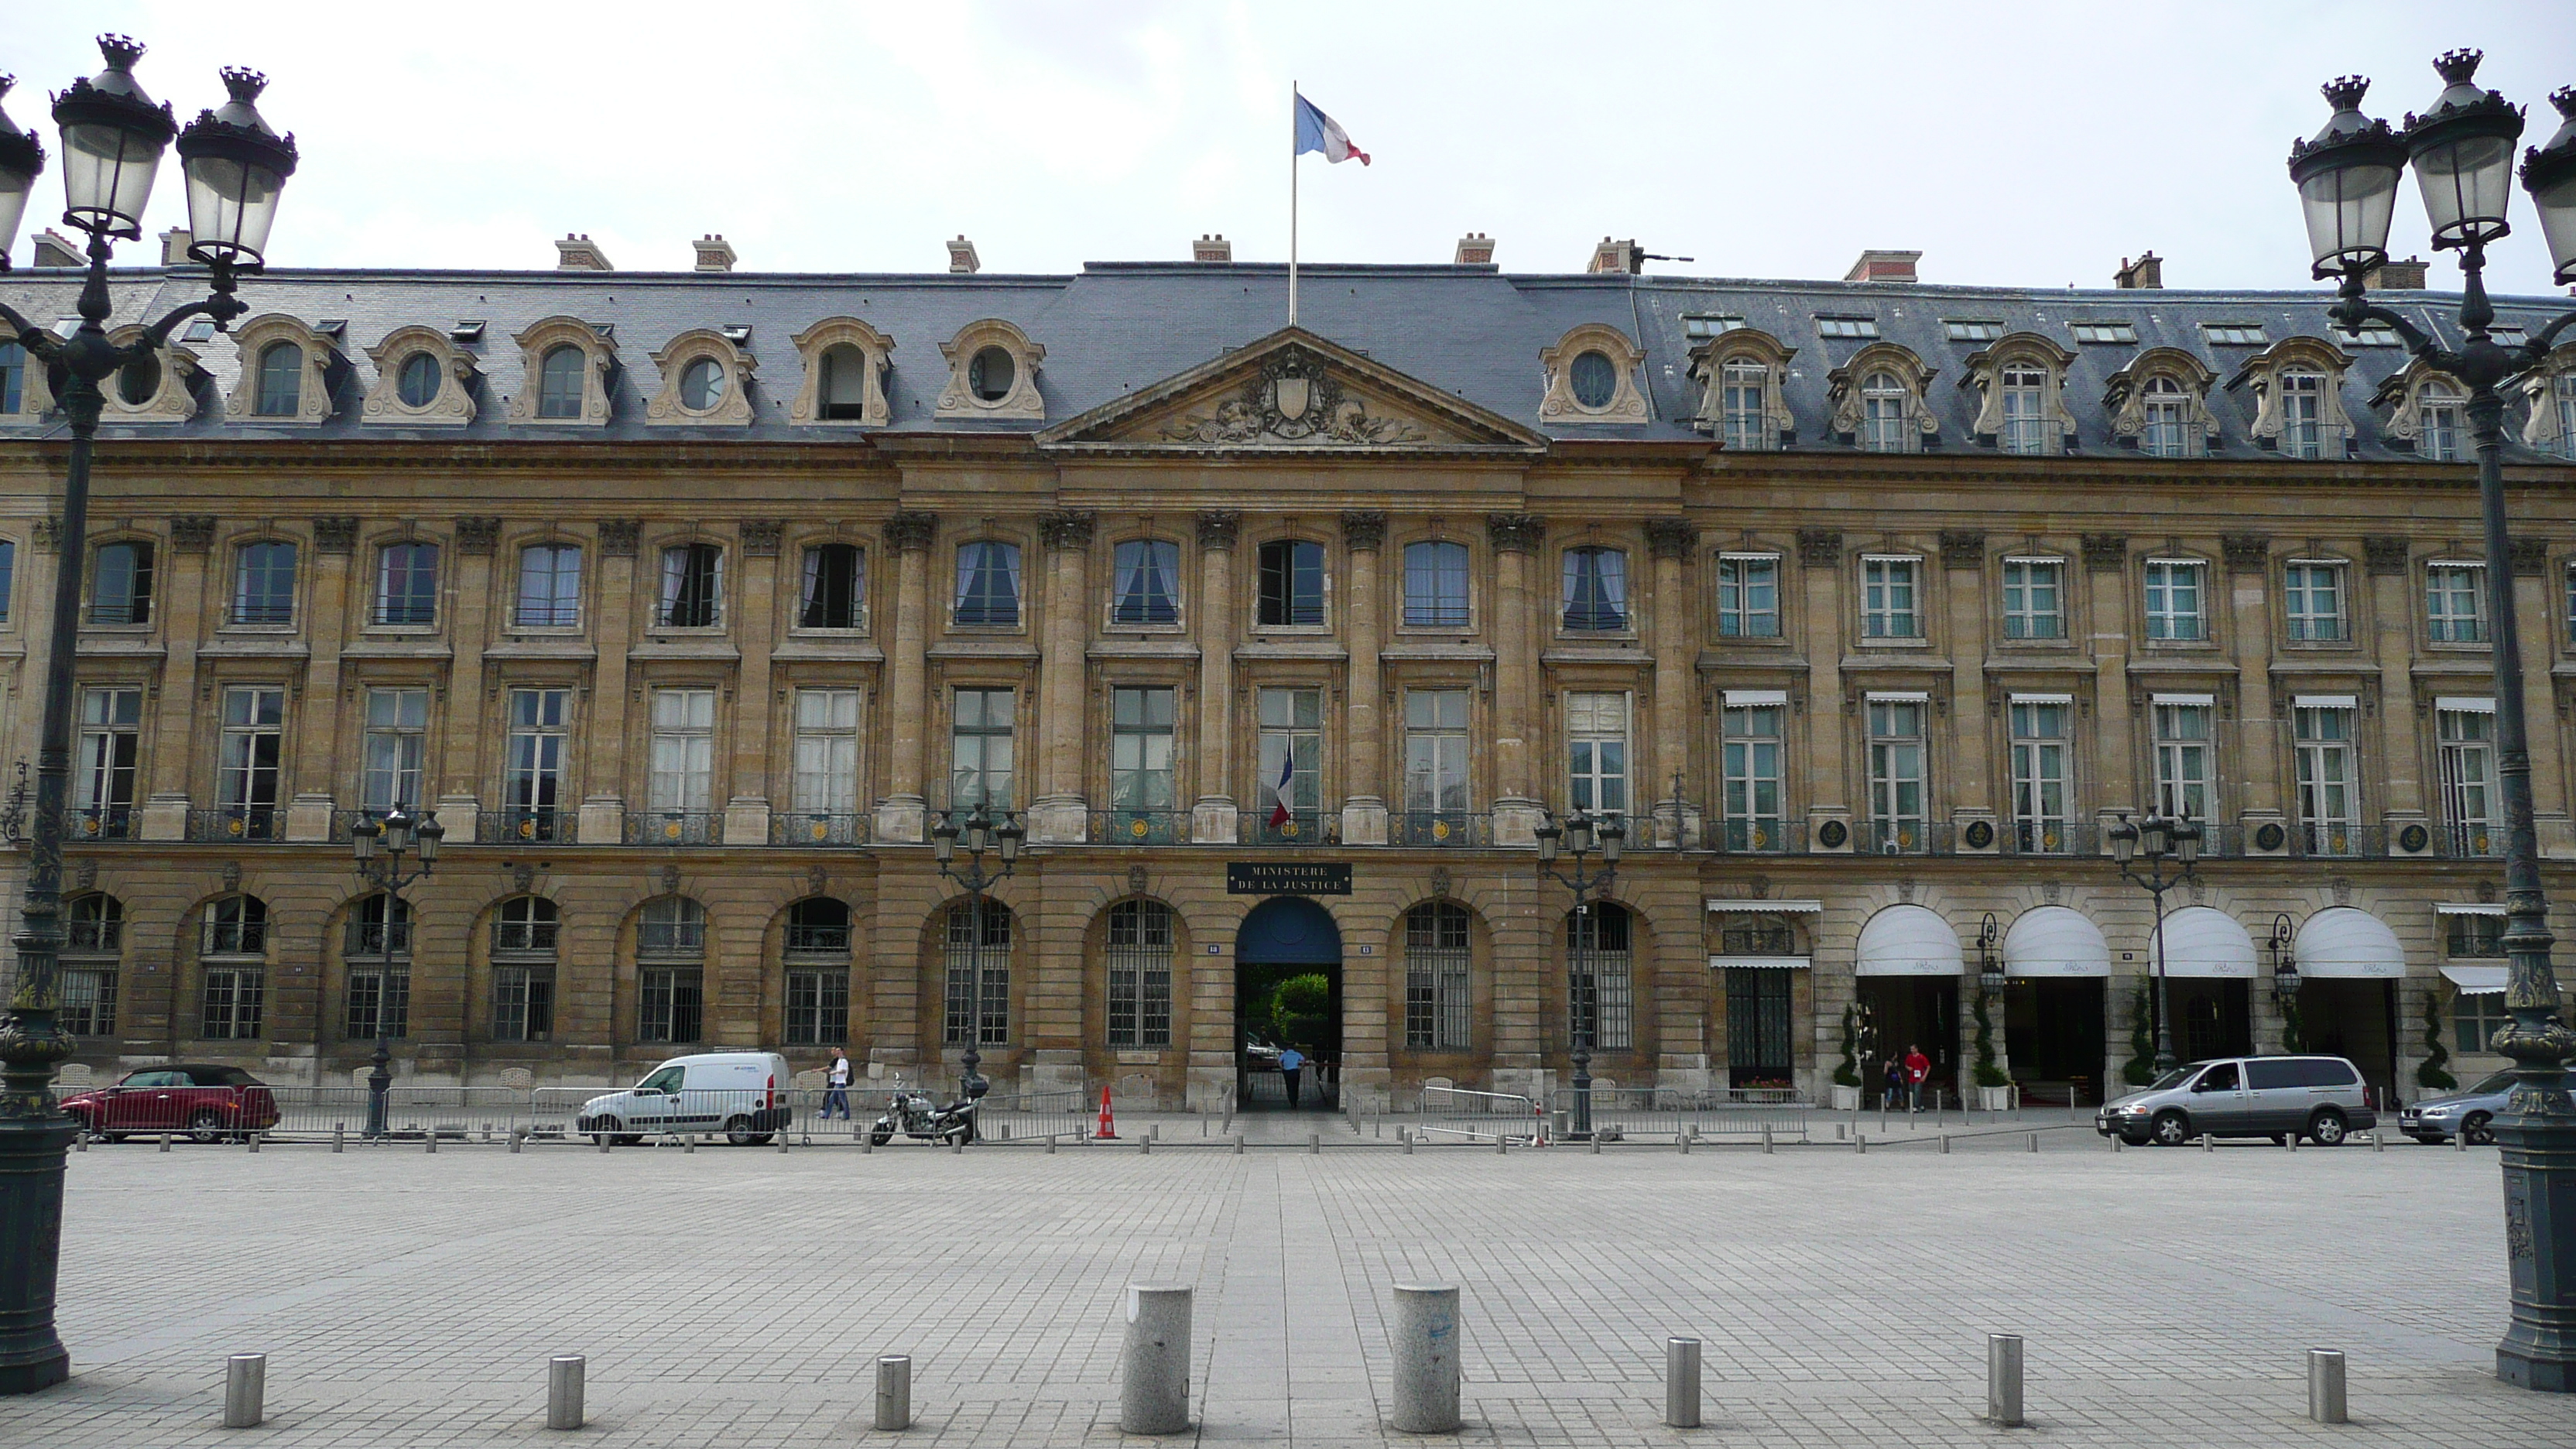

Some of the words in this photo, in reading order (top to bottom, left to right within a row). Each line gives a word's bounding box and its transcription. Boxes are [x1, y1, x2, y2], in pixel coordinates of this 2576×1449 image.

[1252, 867, 1327, 876] MINISTERE
[1238, 880, 1255, 889] DE
[1263, 881, 1277, 889] LA
[1283, 881, 1341, 890] JUSTICE
